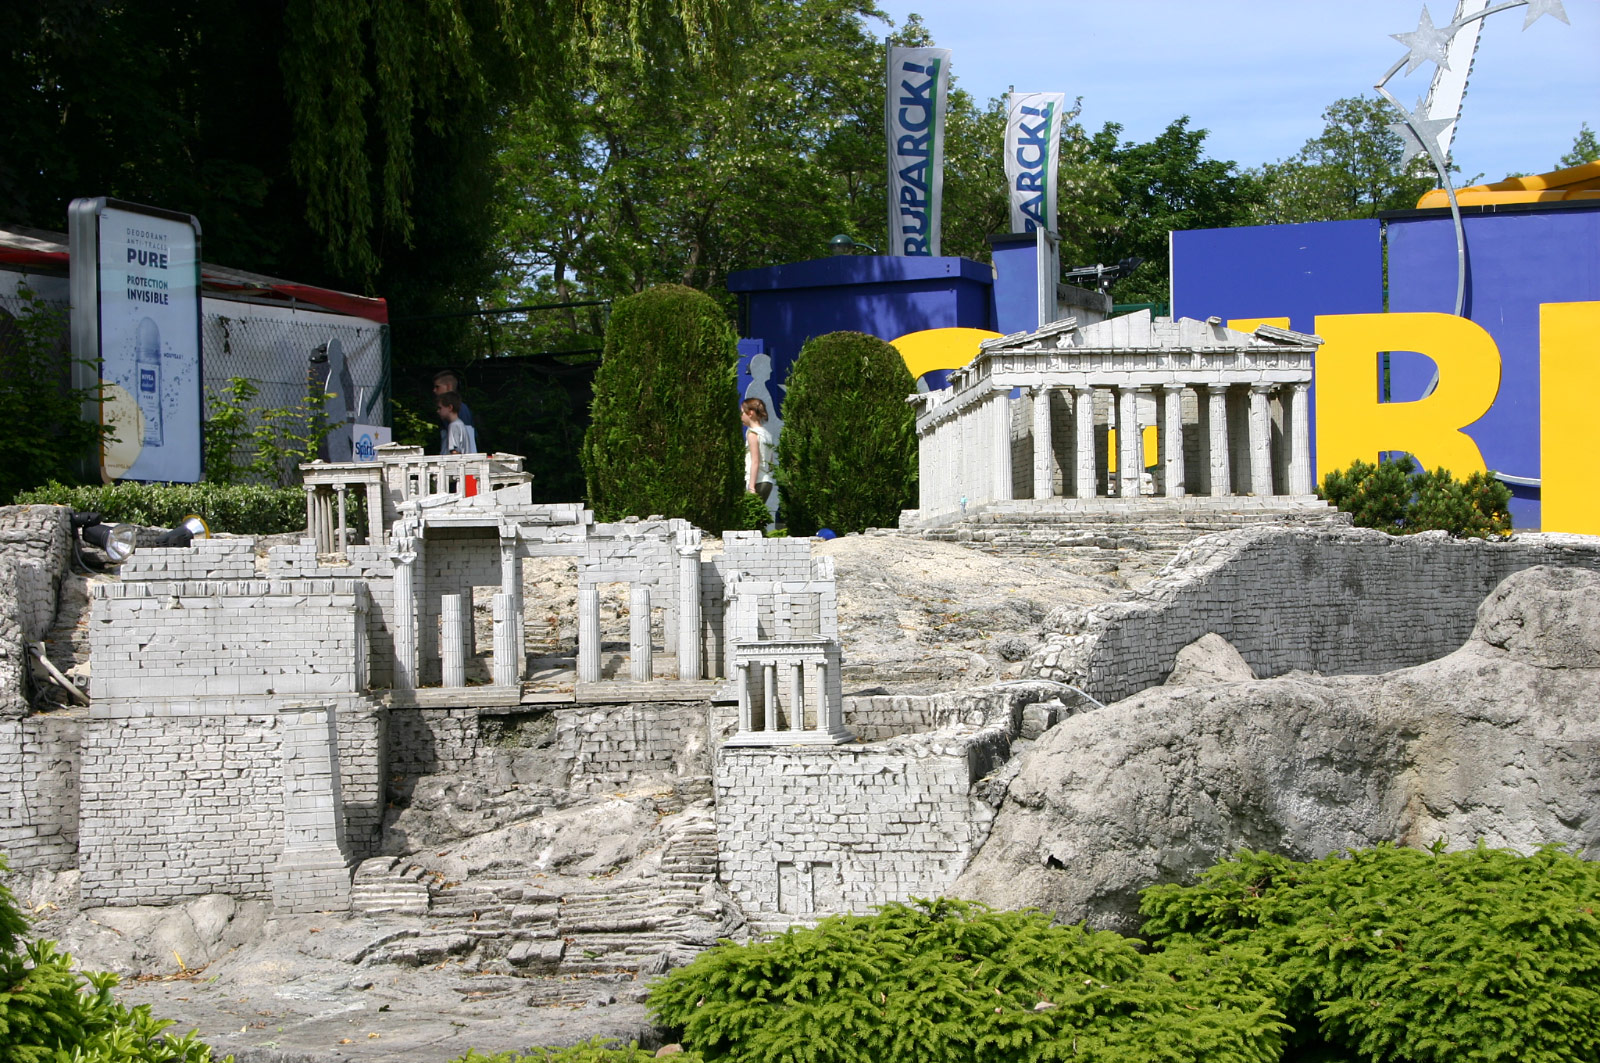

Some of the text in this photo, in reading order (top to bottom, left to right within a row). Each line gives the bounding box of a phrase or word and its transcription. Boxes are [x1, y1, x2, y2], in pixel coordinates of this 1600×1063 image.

[126, 227, 168, 242] DEODORANT
[127, 247, 168, 270] PURE
[127, 274, 169, 290] PROTECTION
[127, 288, 169, 306] INVISIBLE
